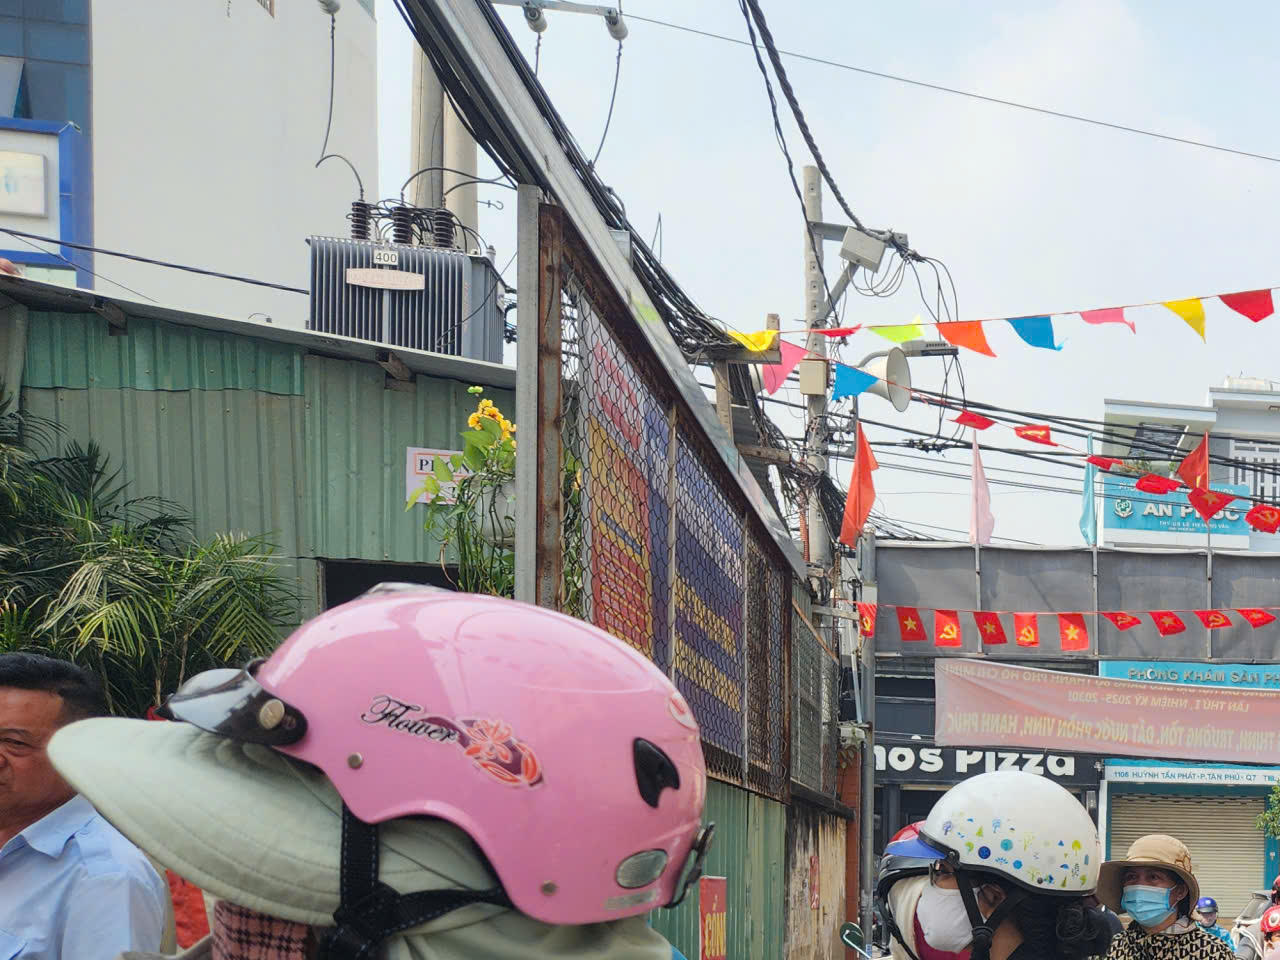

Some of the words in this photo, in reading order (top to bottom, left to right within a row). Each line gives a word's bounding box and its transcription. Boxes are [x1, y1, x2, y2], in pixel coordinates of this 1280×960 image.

[375, 252, 397, 263] 400
[1142, 502, 1173, 517] AN
[1180, 505, 1240, 521] PC
[1183, 668, 1225, 682] KHÁM
[361, 695, 459, 742] Flower
[955, 750, 1075, 776] Pizza
